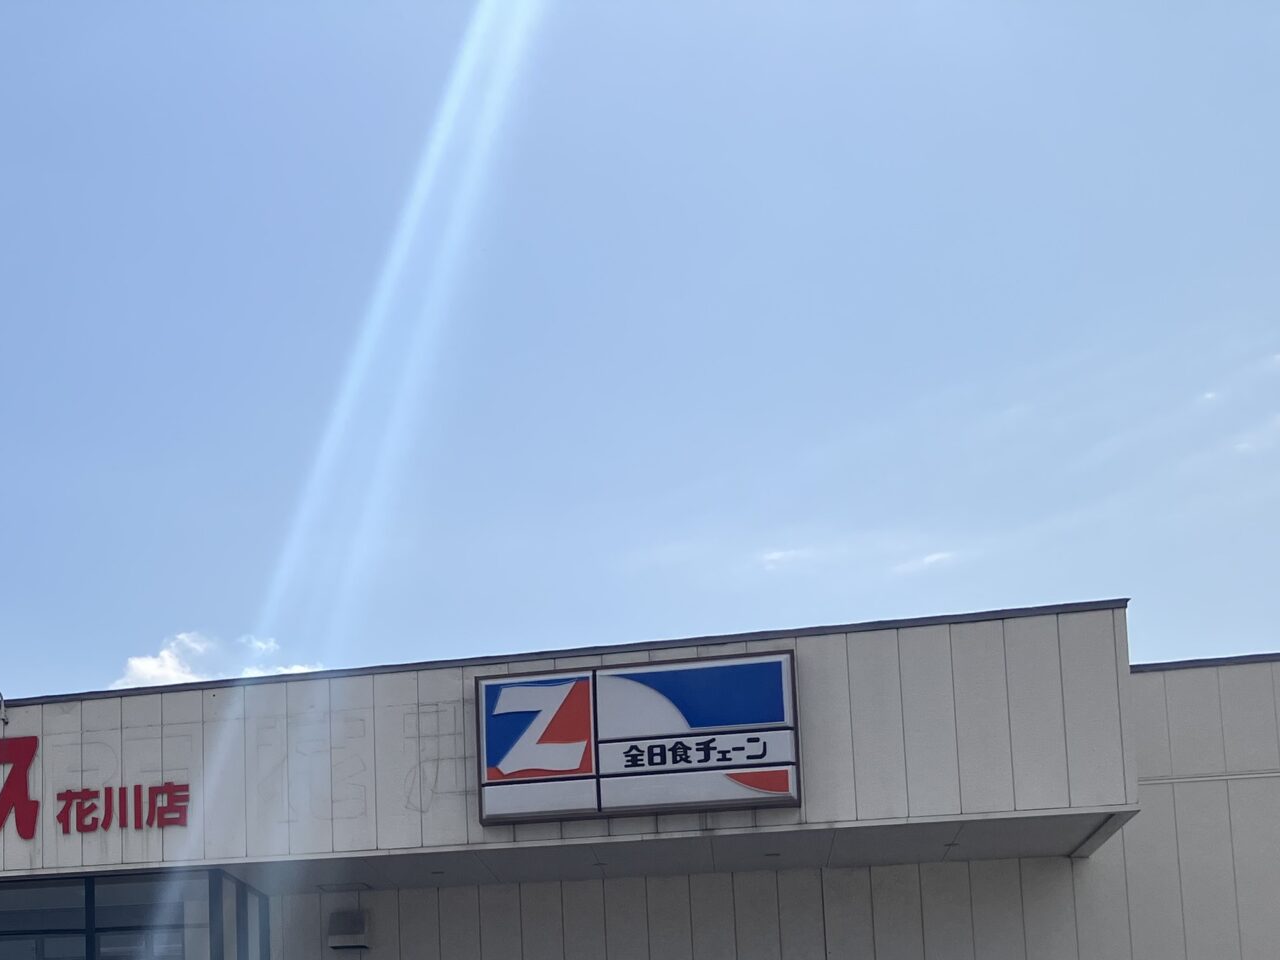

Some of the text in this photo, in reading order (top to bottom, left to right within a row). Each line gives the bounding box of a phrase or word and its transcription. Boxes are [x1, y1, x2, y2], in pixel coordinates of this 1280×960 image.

[492, 680, 587, 776] Z
[622, 736, 767, 769] 全日食チェーン
[56, 782, 191, 835] 花川店
